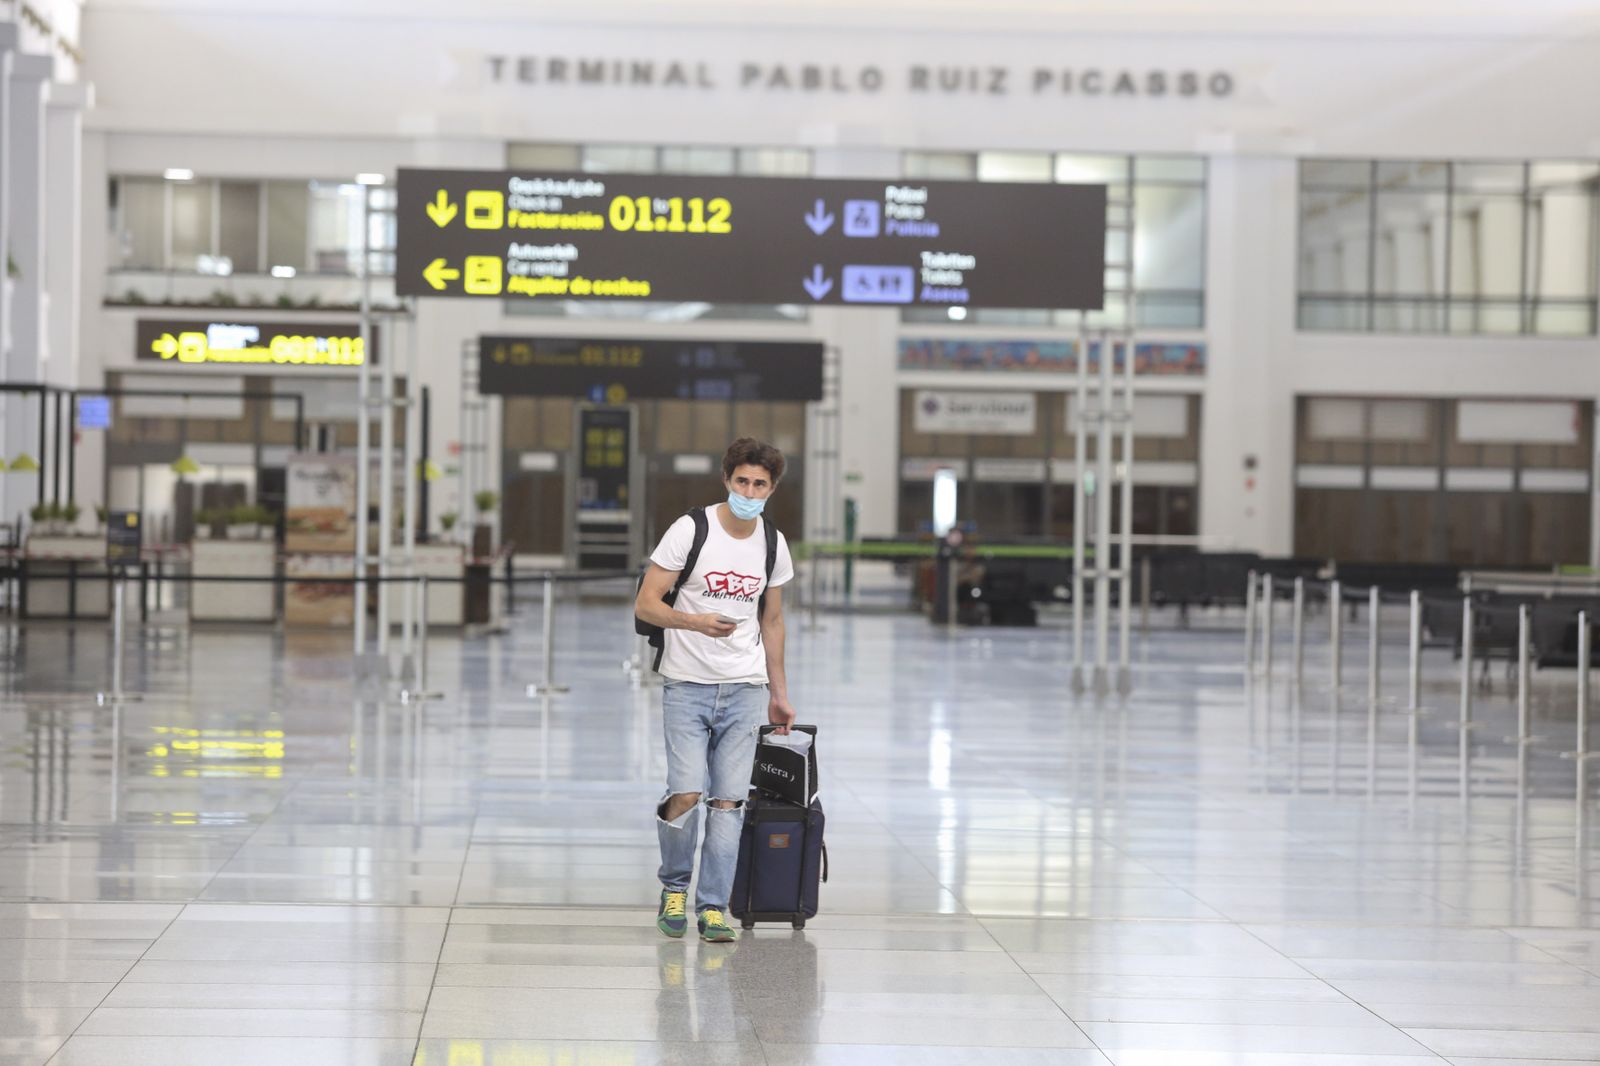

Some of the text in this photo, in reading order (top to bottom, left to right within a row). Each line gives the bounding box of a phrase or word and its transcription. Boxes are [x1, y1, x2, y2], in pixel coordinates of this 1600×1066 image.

[489, 57, 1234, 97] TERMINAL PABLO RUIZ PICASSO
